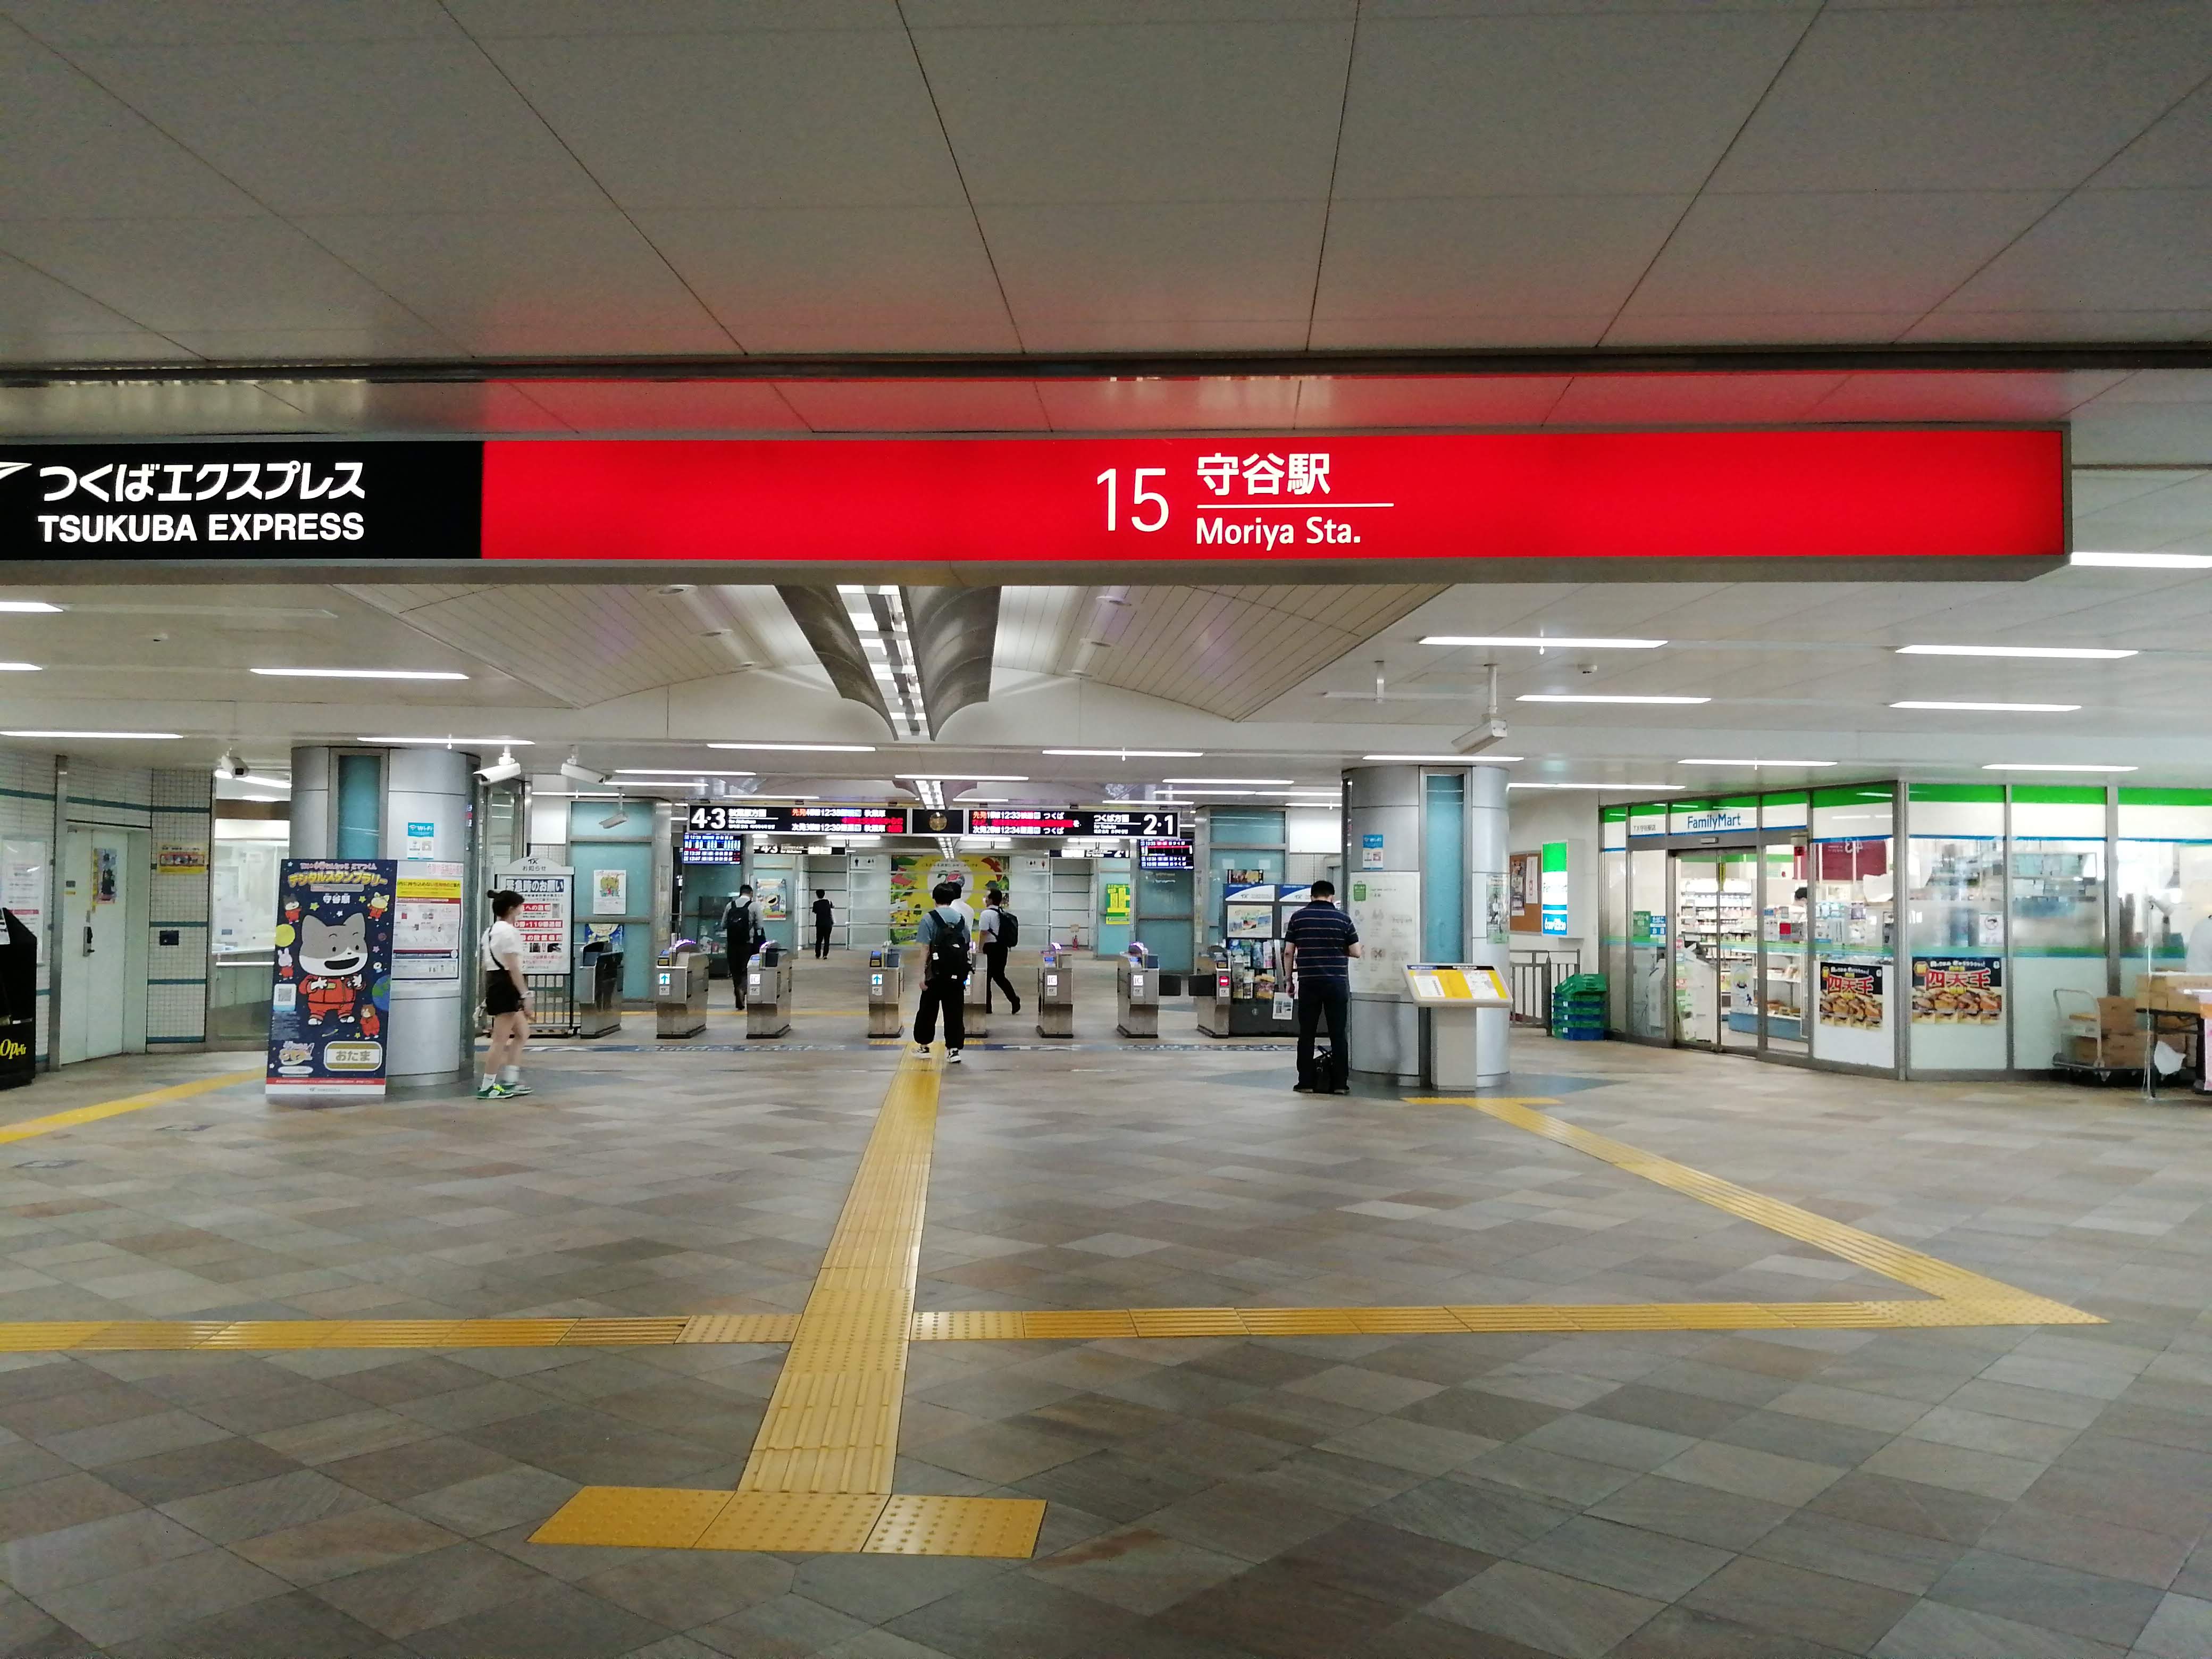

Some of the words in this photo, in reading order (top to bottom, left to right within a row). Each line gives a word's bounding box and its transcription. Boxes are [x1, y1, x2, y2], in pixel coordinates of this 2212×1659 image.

[39, 460, 365, 502] つくばエクスプレス
[1196, 453, 1331, 496] 守谷駅
[1096, 468, 1169, 532] 15
[38, 515, 197, 543] TSUKUBA
[208, 513, 365, 541] EXPRESS
[1196, 517, 1294, 551] Moriya
[1306, 516, 1361, 544] Sta.
[1094, 814, 1129, 823] つくば方
[1687, 814, 1741, 830] FamilyMart
[288, 870, 388, 887] デジタルスタンプラリー
[1828, 975, 1874, 998] 四天王
[1926, 968, 1991, 991] 四天王
[336, 1050, 371, 1061] おたま
